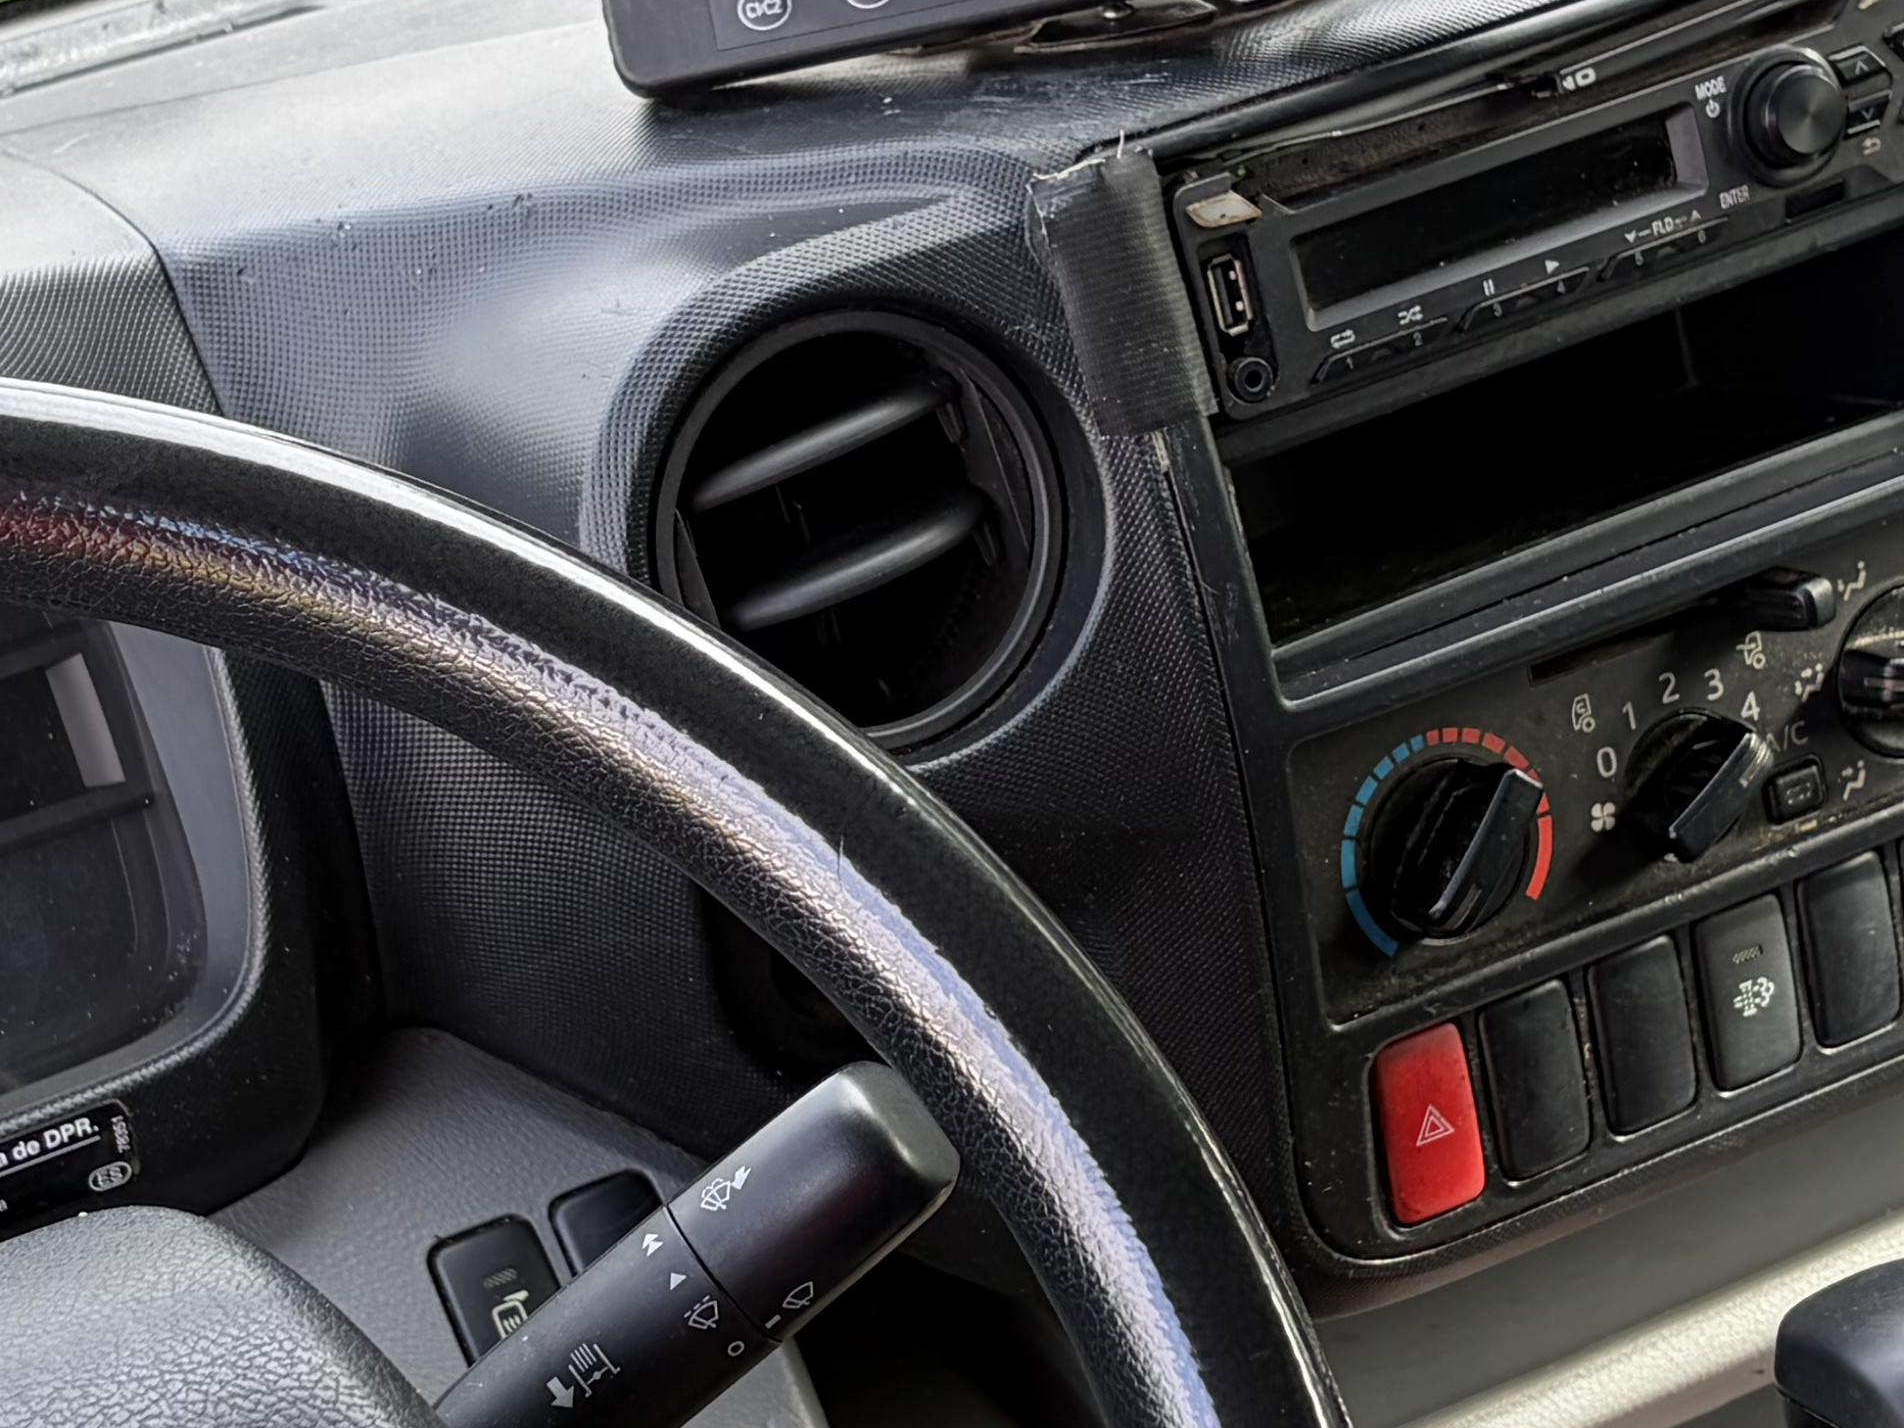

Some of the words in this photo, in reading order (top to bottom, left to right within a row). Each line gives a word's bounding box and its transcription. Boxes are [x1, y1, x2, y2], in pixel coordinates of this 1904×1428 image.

[1695, 76, 1727, 100] MODE
[1719, 184, 1750, 210] ENTER
[1412, 332, 1424, 347] 2
[1493, 302, 1503, 317] 3
[1622, 701, 1637, 730] 1
[1658, 672, 1680, 704] 2
[1704, 668, 1725, 701] 3
[1740, 691, 1761, 721] 4
[1765, 721, 1809, 753] A/C
[13, 1141, 40, 1160] de
[44, 1118, 98, 1148] DPR.
